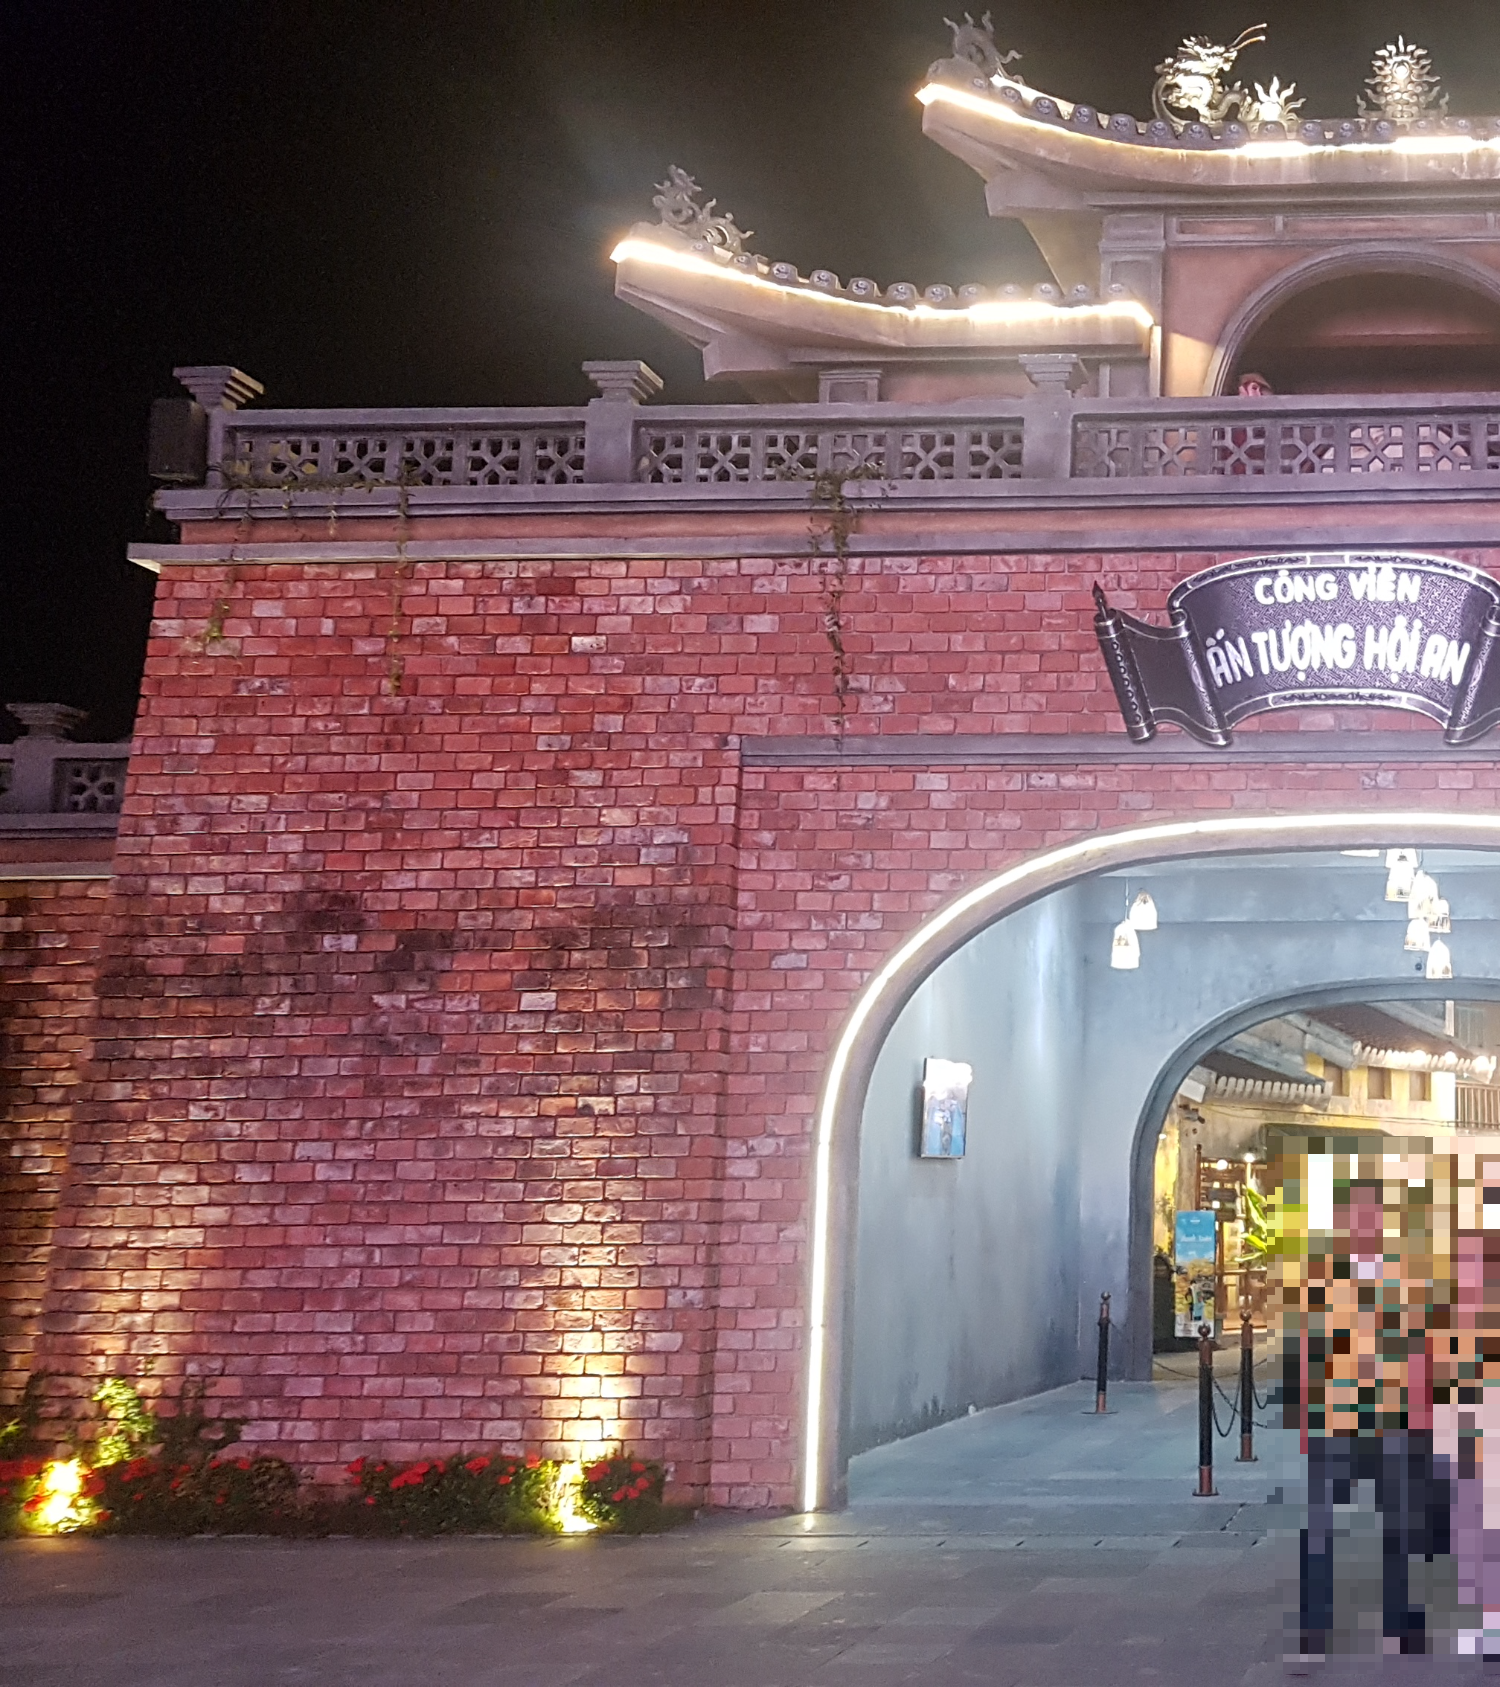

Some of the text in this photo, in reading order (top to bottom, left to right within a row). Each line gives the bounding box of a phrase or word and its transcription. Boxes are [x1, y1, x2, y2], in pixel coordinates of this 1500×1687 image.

[1254, 566, 1421, 605] CÔNG VIÊN
[1206, 615, 1470, 688] ẤN TƯỢNG HỘI AN
